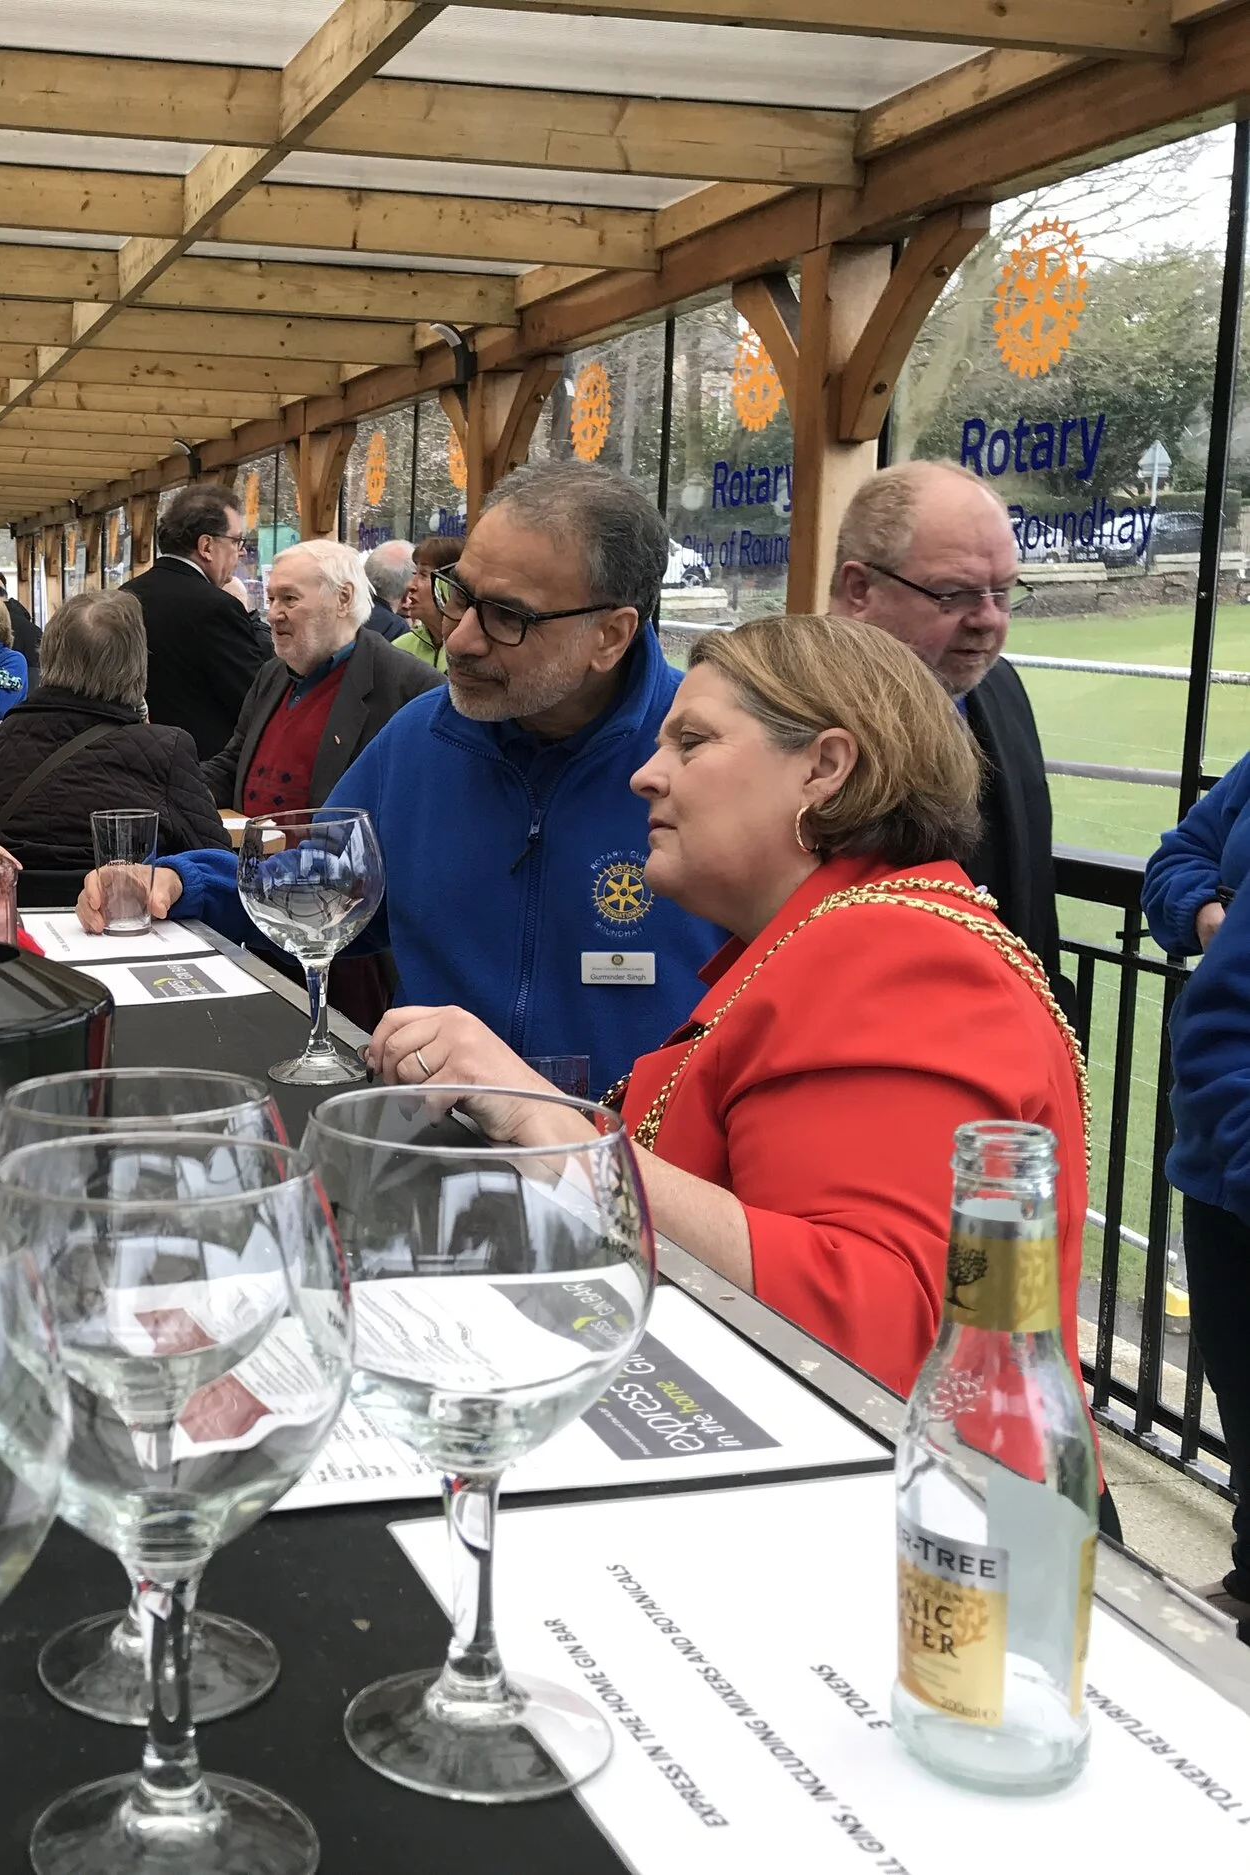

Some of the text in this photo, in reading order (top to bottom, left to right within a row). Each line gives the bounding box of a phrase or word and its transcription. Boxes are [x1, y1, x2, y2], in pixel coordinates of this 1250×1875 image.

[960, 413, 1105, 480] Rotary
[712, 461, 791, 512] Rotary
[1007, 497, 1157, 556] Roundhay
[682, 533, 714, 568] Club
[719, 530, 737, 567] of
[591, 850, 647, 870] ROTARY CLU
[611, 867, 642, 878] ROTARY
[627, 973, 646, 981] Singh
[610, 1382, 705, 1451] express
[656, 1380, 703, 1414] home
[693, 1413, 726, 1436] the
[718, 1432, 742, 1447] in
[810, 1664, 878, 1718] TOKENS
[543, 1618, 729, 1828] EXPRESS IN THE HOME GIN BAR
[606, 1564, 913, 1875] LL GINS, INCLUDING MIXERS AND BOTANICALS
[867, 1720, 893, 1730] 3
[1166, 1758, 1243, 1812] TOKEN
